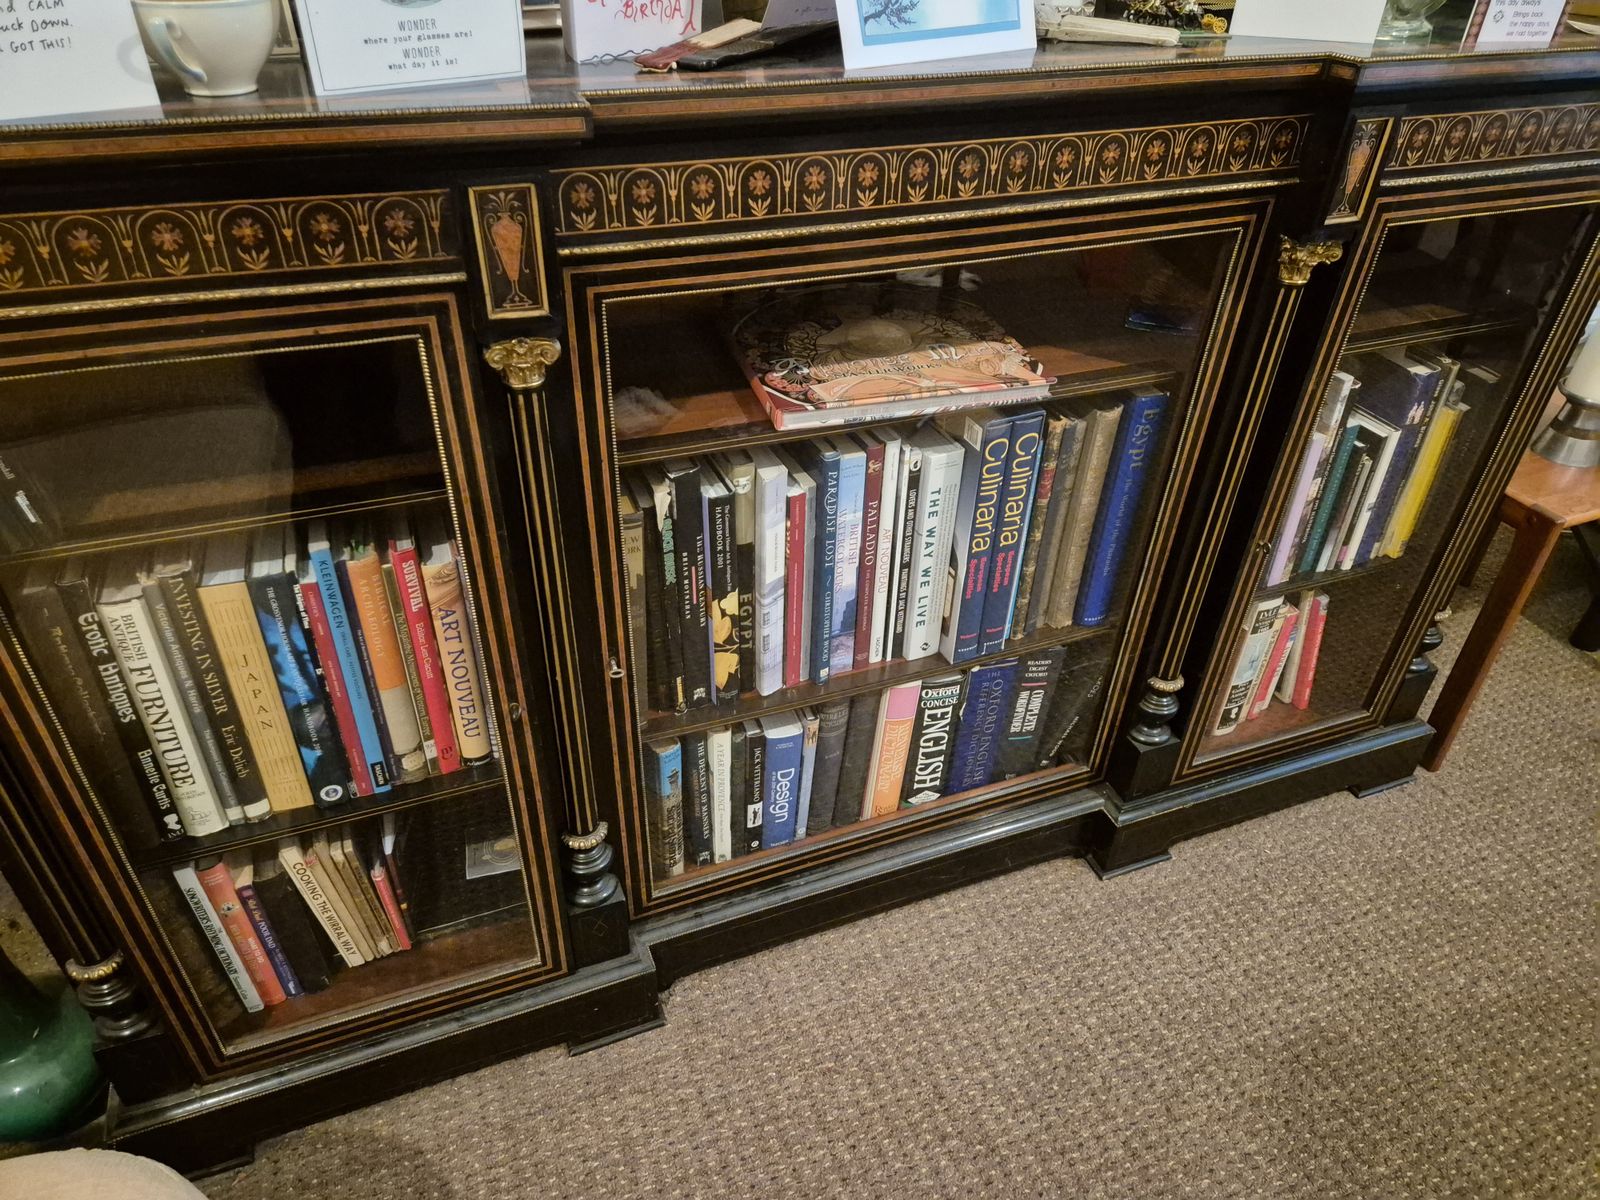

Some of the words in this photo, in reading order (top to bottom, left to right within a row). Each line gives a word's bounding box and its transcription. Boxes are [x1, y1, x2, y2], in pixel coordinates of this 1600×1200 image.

[28, 0, 64, 11] CALM
[0, 17, 24, 32] uck
[31, 18, 73, 32] DOWN.
[364, 36, 388, 45] where
[393, 35, 411, 44] your
[455, 30, 473, 38] are!
[398, 18, 438, 32] WONDER
[10, 40, 34, 53] GOT
[39, 36, 72, 50] THIS!
[402, 45, 442, 59] WONDER
[388, 62, 407, 70] what
[412, 61, 426, 69] day
[445, 58, 459, 66] is!
[1125, 405, 1161, 471] Egypt
[822, 469, 838, 534] PARADISE
[907, 488, 916, 507] LOVERS
[927, 488, 941, 519] THE
[971, 435, 1009, 554] Culinaria
[999, 430, 1039, 547] Culinaria
[712, 506, 724, 551] HANDBOOK
[904, 520, 913, 536] OTHER
[906, 508, 914, 520] AND
[831, 507, 849, 594] WATERCOLOURS
[846, 522, 859, 565] BRITISH
[863, 499, 879, 566] PALLADIO
[881, 526, 890, 545] ART
[901, 536, 911, 563] STRANGERS
[923, 526, 936, 559] WAY
[681, 551, 689, 576] BRIAN
[695, 554, 706, 589] RUSSIAN
[716, 552, 724, 568] 2001
[823, 539, 834, 569] LOST
[877, 547, 889, 594] NOUVEAU
[992, 551, 1005, 593] Specialties
[1002, 549, 1014, 585] European
[292, 583, 302, 593] The
[400, 559, 425, 611] SURVIVAL
[919, 566, 931, 588] WE
[964, 558, 977, 599] Specialties
[974, 555, 986, 592] European
[265, 587, 275, 599] THE
[316, 559, 345, 629] KLEINWAGEN
[371, 573, 389, 626] BIBLICAL
[682, 578, 692, 619] MOYNAHAN
[696, 590, 707, 627] CENTURY
[897, 598, 905, 610] JACK
[166, 577, 207, 651] INVESTING
[358, 577, 383, 658] ARCHAEOLOGY
[395, 612, 405, 622] The
[436, 605, 463, 645] ART
[739, 593, 752, 649] EGYPT
[822, 591, 831, 638] CHRISTOPHER
[915, 595, 927, 628] LIVE
[106, 614, 134, 663] ANTIQUE
[120, 613, 147, 660] BRITISH
[420, 644, 430, 658] Len
[76, 611, 112, 656] Erotic
[94, 661, 140, 724] Antiques
[153, 603, 176, 642] Victorian
[167, 643, 190, 679] Antiques
[186, 689, 202, 713] Harris
[194, 653, 213, 669] IN
[422, 657, 435, 679] Cacutt
[201, 671, 229, 715] SILVER
[240, 654, 274, 731] JAPAN
[414, 694, 427, 715] Western
[443, 648, 485, 738] NOUVEAU
[921, 685, 960, 699] Oxford
[921, 696, 959, 709] CONCISE
[971, 680, 991, 731] REFERENCE
[981, 677, 1005, 733] OXFORD
[127, 661, 195, 789] FURNITURE
[418, 716, 431, 736] Europe
[1008, 689, 1031, 734] WORDFINDER
[1021, 688, 1045, 733] COMPLETE
[220, 724, 239, 745] Eric
[913, 705, 952, 790] ENGLISH
[716, 768, 723, 776] IN
[753, 746, 761, 763] JACK
[875, 722, 901, 794] DICTIONARY
[959, 733, 980, 788] DICTIONARY
[970, 734, 992, 785] ENGLISH
[136, 748, 164, 784] Annette
[150, 783, 174, 810] Curtis
[373, 764, 384, 784] TASCHEN
[698, 758, 706, 792] DESCENT
[752, 764, 760, 802] VETTRIANO
[700, 793, 707, 803] OF
[717, 777, 725, 812] PROVENCE
[768, 767, 794, 824] Design
[701, 804, 709, 839] MANNERS
[289, 861, 325, 901] COOKING
[315, 901, 332, 914] THE
[257, 921, 271, 936] POOR
[264, 936, 276, 948] DAD
[323, 914, 349, 939] WIRRAL
[202, 923, 225, 948] RHYMING
[215, 947, 240, 975] DICTIONARY
[339, 939, 357, 956] WAY
